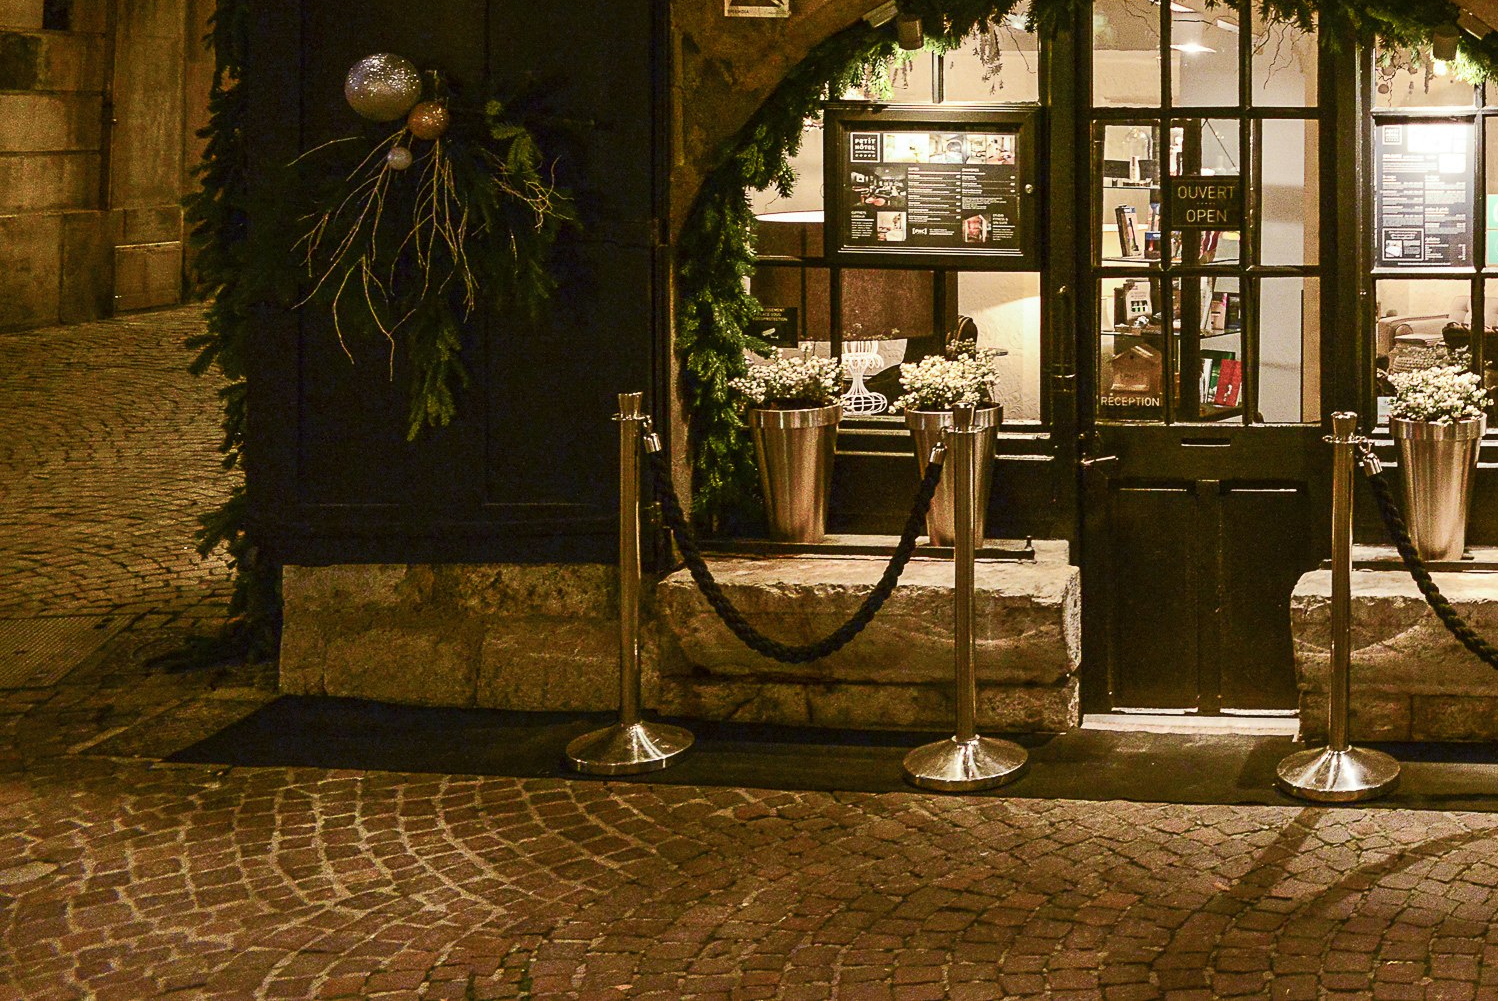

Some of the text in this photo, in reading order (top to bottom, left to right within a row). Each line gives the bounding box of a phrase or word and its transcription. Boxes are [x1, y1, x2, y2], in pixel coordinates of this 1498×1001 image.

[1177, 185, 1236, 200] OUVERT
[1186, 209, 1228, 223] OPEN
[1100, 392, 1161, 407] RÉCEPTION
